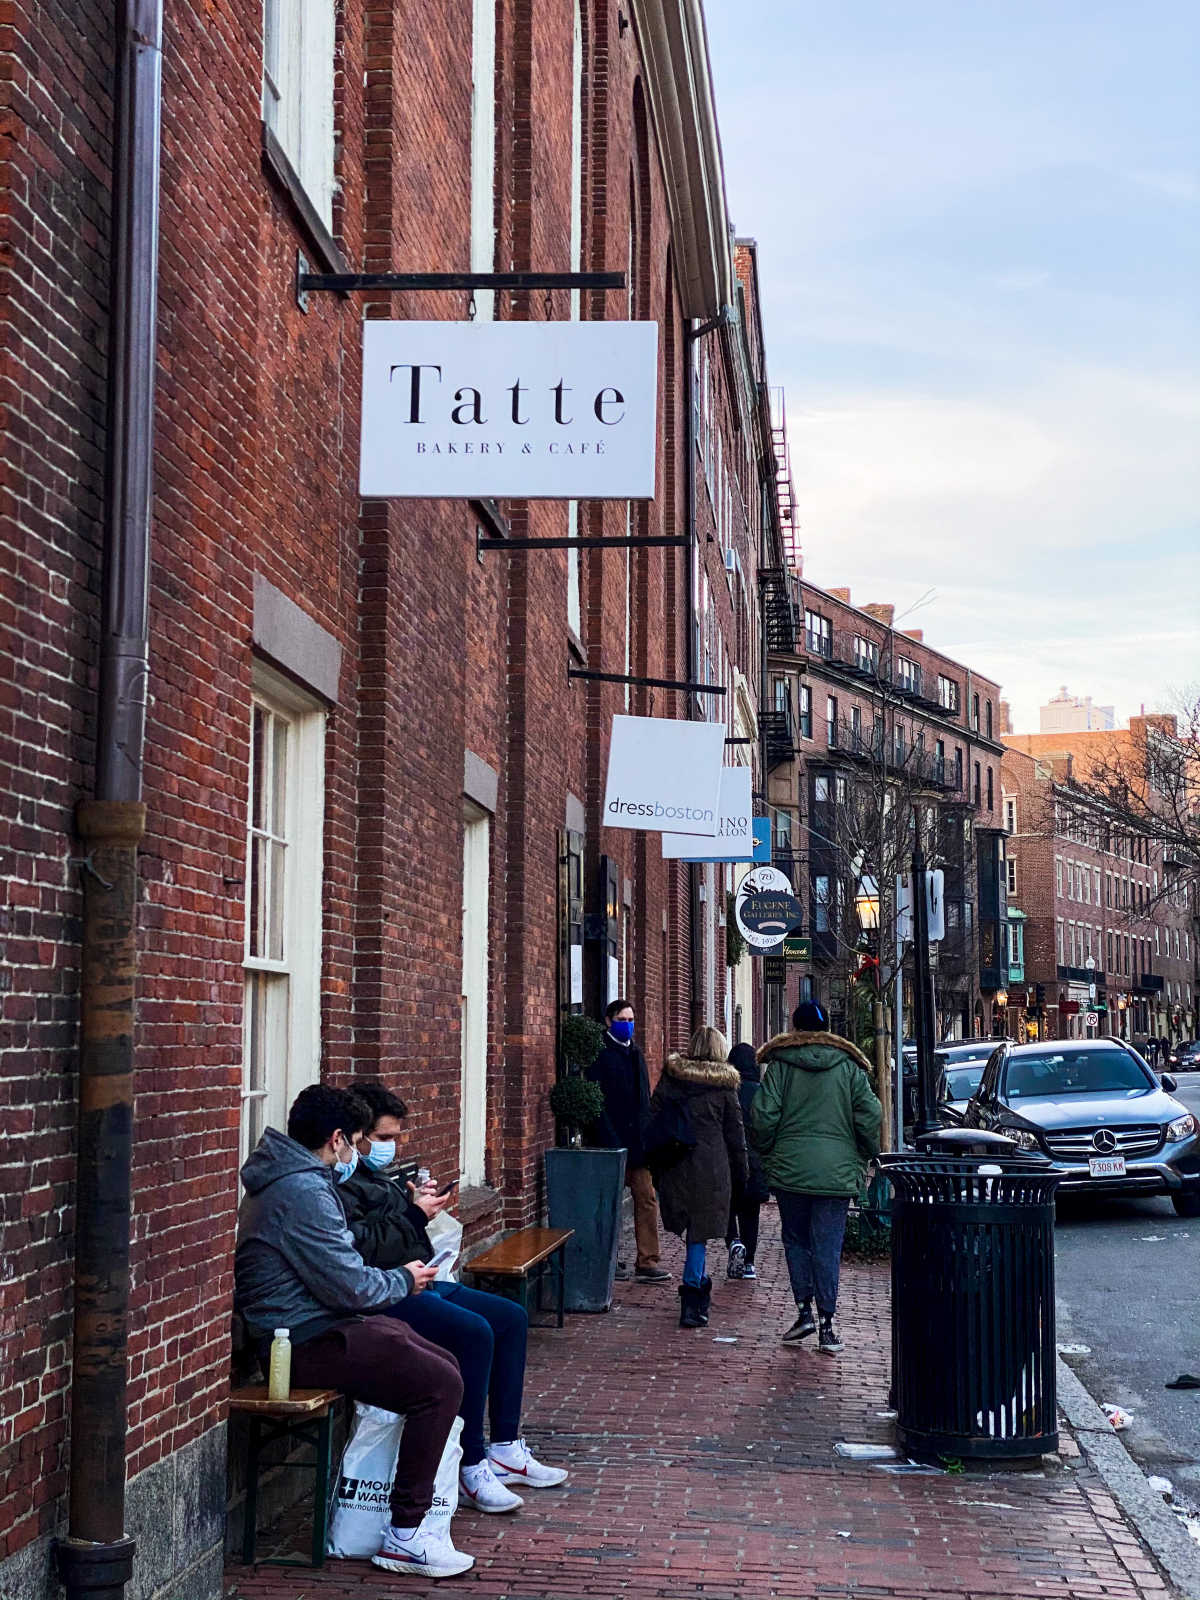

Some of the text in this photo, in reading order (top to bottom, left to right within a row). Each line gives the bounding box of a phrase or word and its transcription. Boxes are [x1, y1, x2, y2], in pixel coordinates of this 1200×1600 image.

[390, 364, 626, 426] Tatte
[416, 439, 606, 455] BAKERY & CAFÉ
[608, 796, 714, 822] dressboston
[720, 816, 748, 828] INO
[718, 827, 748, 837] ALON
[751, 900, 792, 910] EUGENE
